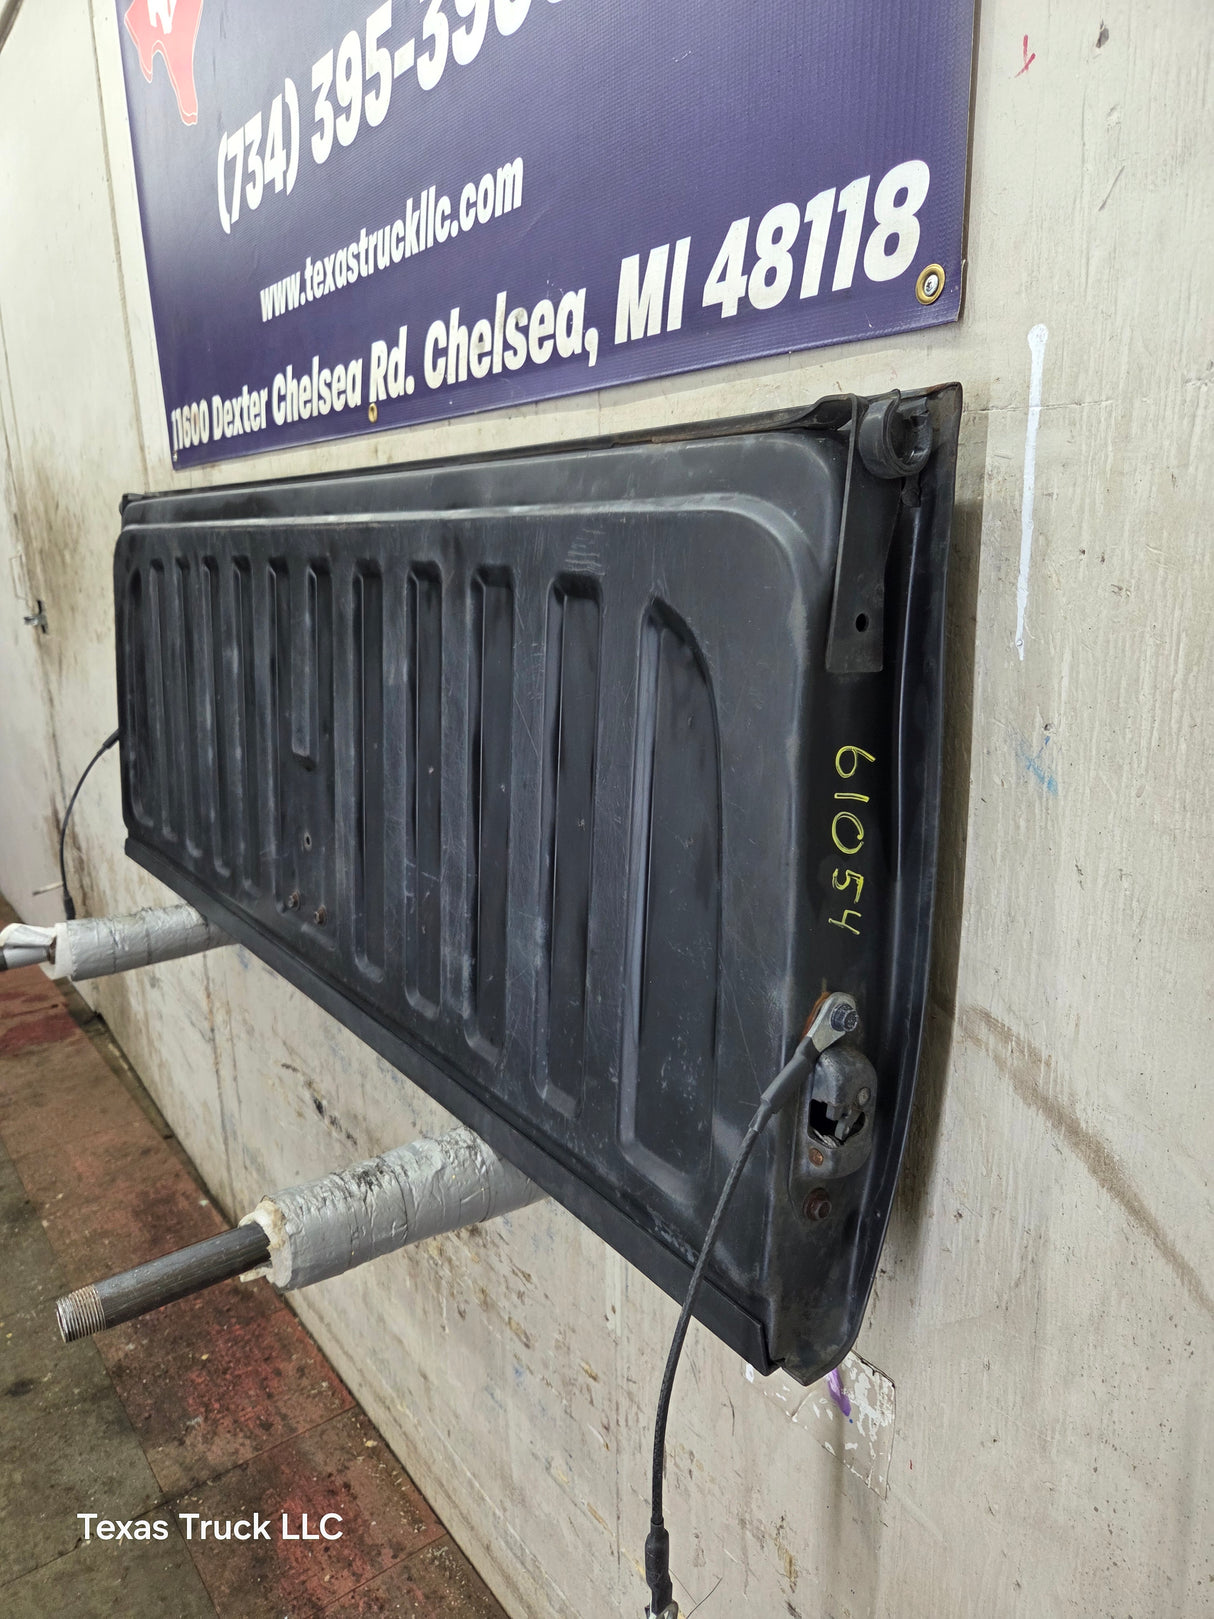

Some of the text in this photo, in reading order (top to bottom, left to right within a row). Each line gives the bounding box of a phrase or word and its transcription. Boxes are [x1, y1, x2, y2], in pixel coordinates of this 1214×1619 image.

[217, 0, 564, 234] (734) 395-39
[171, 159, 931, 449] 11600 Dexter Chelsea Rd. Chelsea, MI 48118
[260, 157, 524, 322] www.texastruckllc.com
[828, 745, 876, 935] 61054
